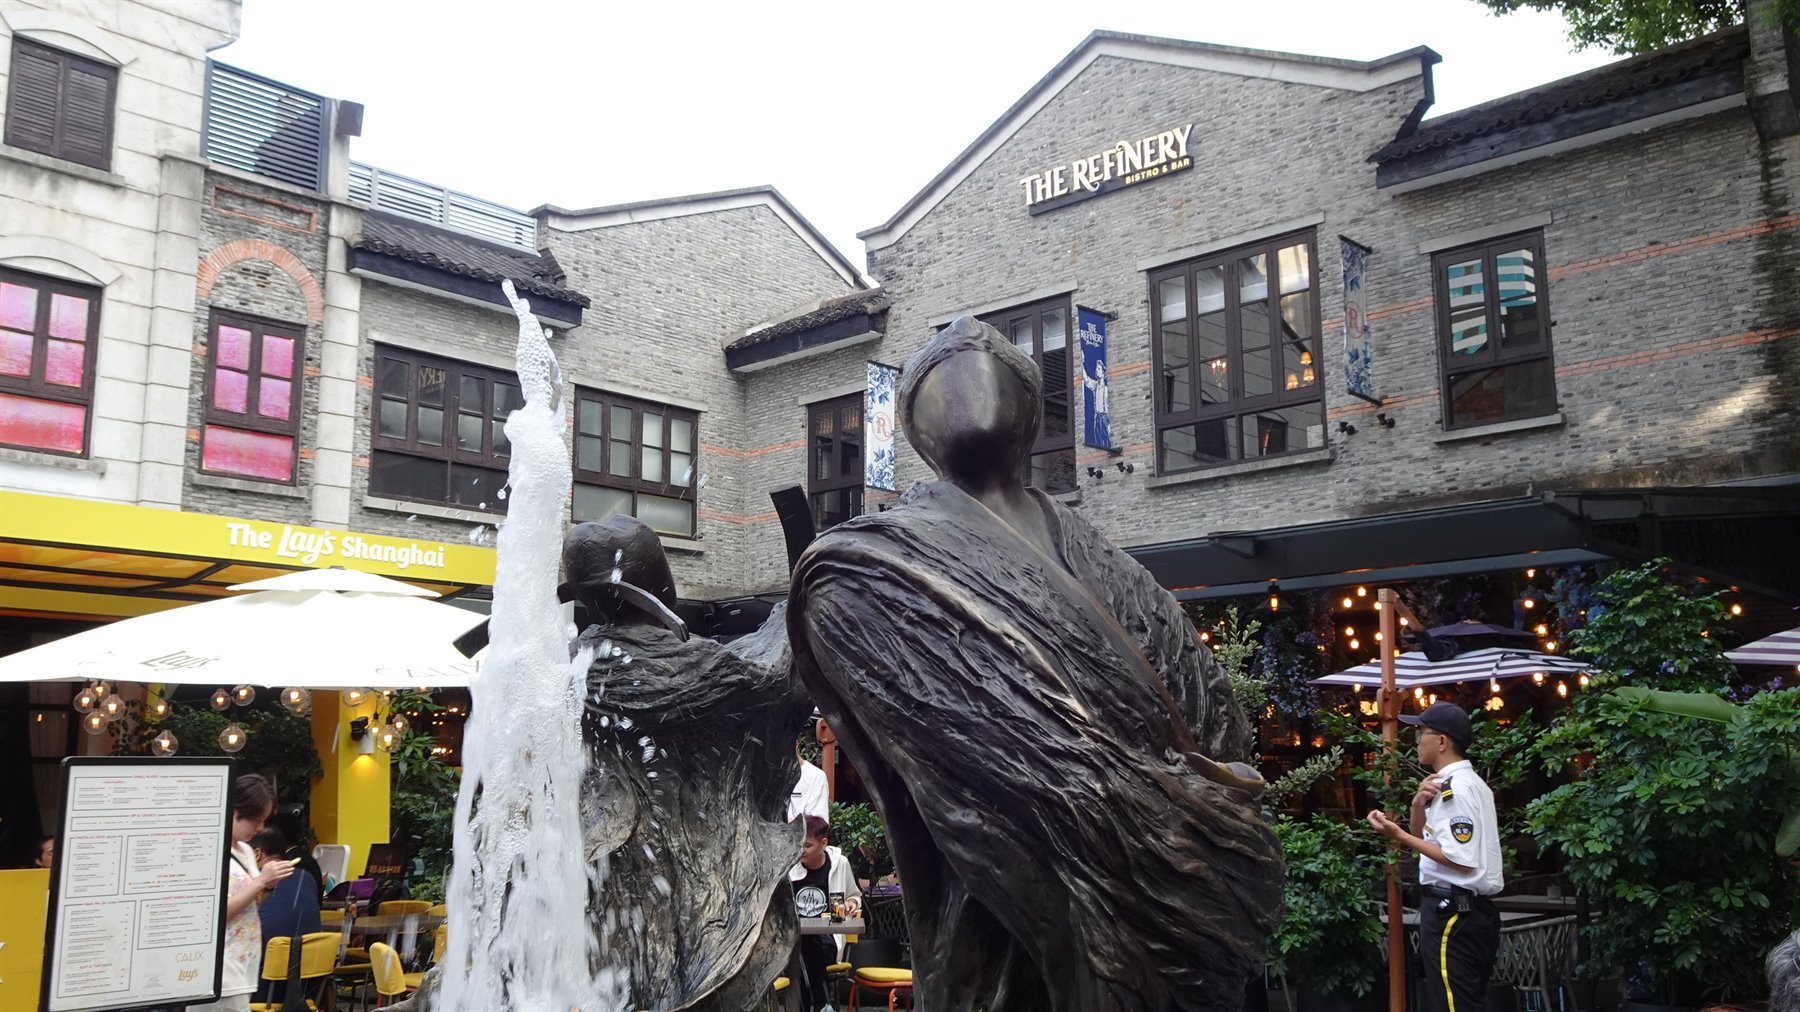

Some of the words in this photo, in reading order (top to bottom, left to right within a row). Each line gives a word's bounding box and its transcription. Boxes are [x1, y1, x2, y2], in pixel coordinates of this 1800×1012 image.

[1019, 165, 1068, 206] THE
[1072, 124, 1193, 192] REFINERY
[1125, 169, 1158, 184] BISTRO
[1171, 158, 1190, 171] BAR
[1087, 322, 1097, 332] THE
[1080, 329, 1104, 344] REFINERY
[877, 416, 889, 437] R
[226, 522, 272, 548] The
[276, 526, 336, 565] Lay's
[341, 536, 445, 569] Shanghai
[176, 951, 204, 962] CALIX
[178, 969, 198, 982] Lay's
